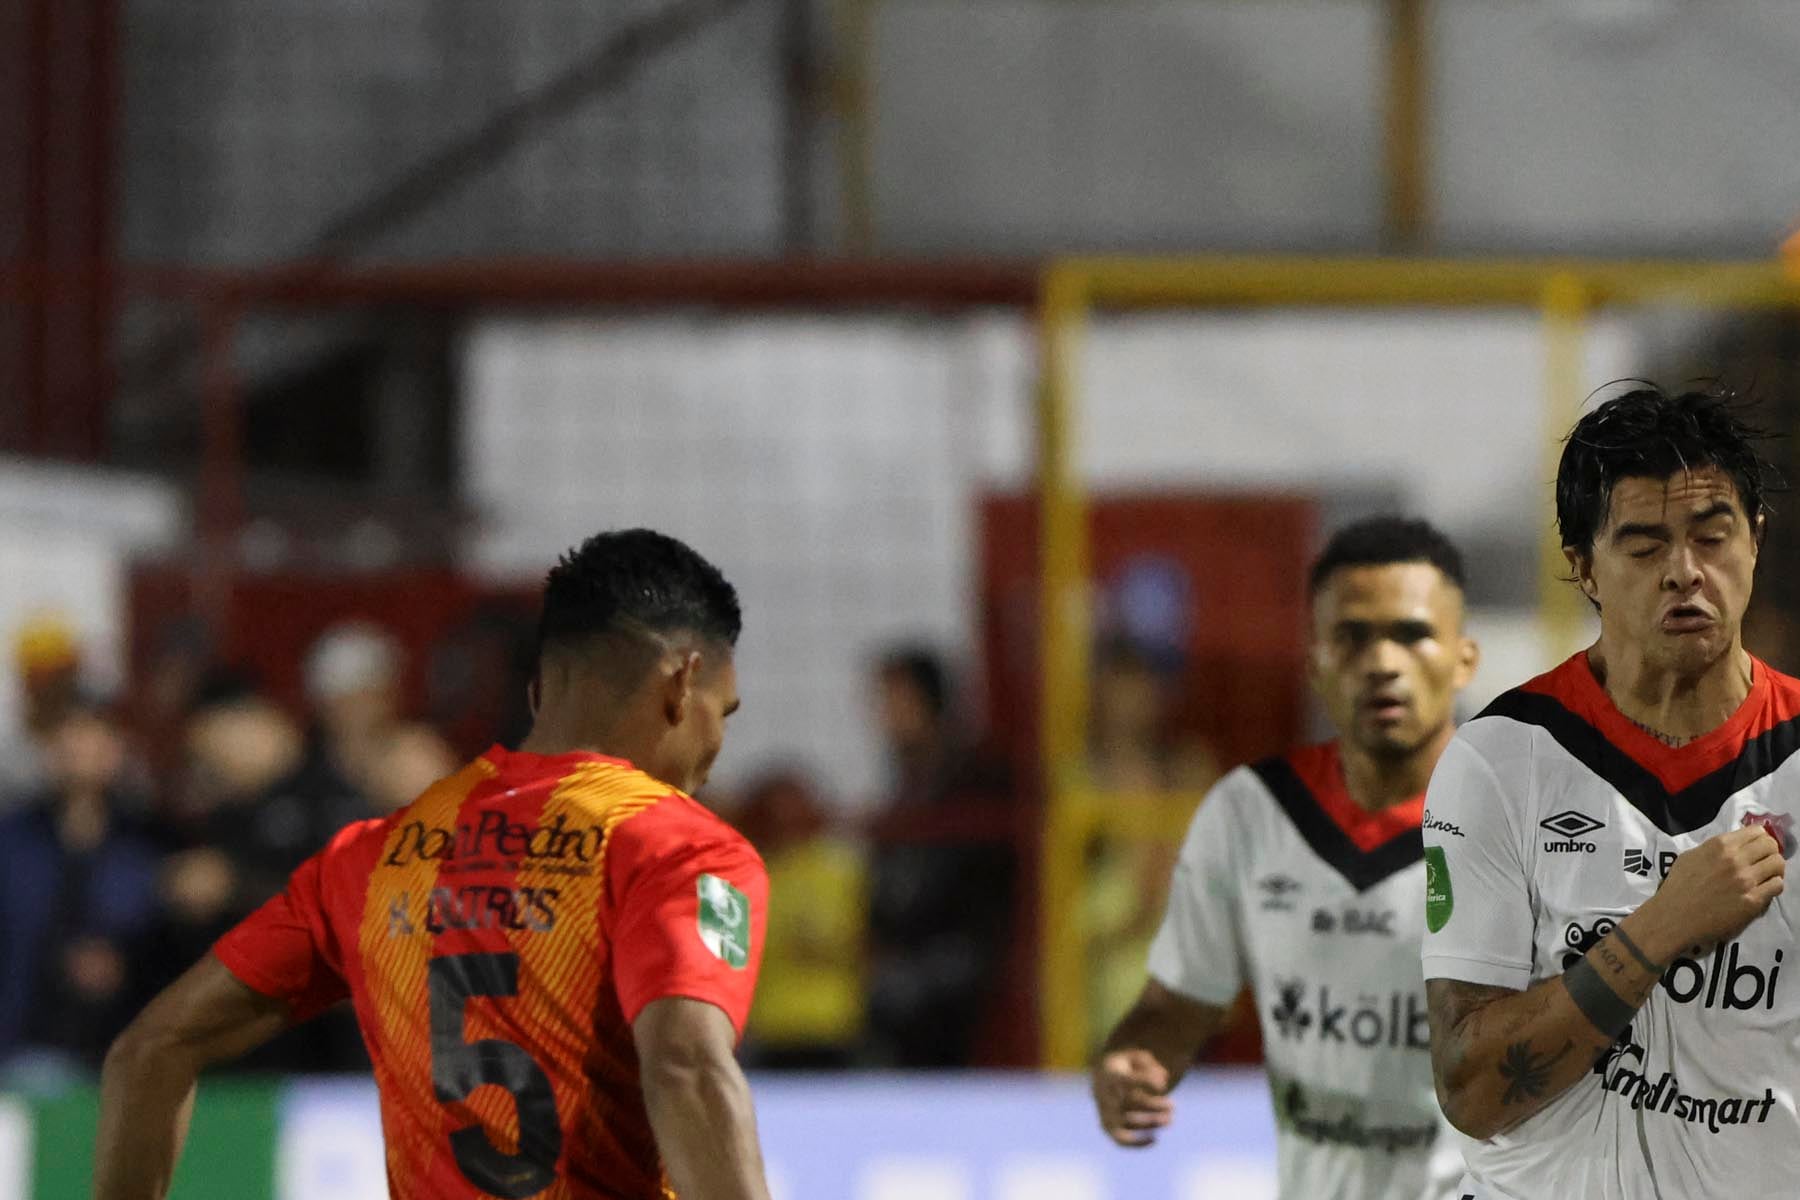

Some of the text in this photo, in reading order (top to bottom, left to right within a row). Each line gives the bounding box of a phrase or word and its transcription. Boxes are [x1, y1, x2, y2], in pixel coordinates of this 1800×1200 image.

[1544, 840, 1597, 853] umbro
[1658, 942, 1784, 1010] olbi
[427, 952, 563, 1200] 5
